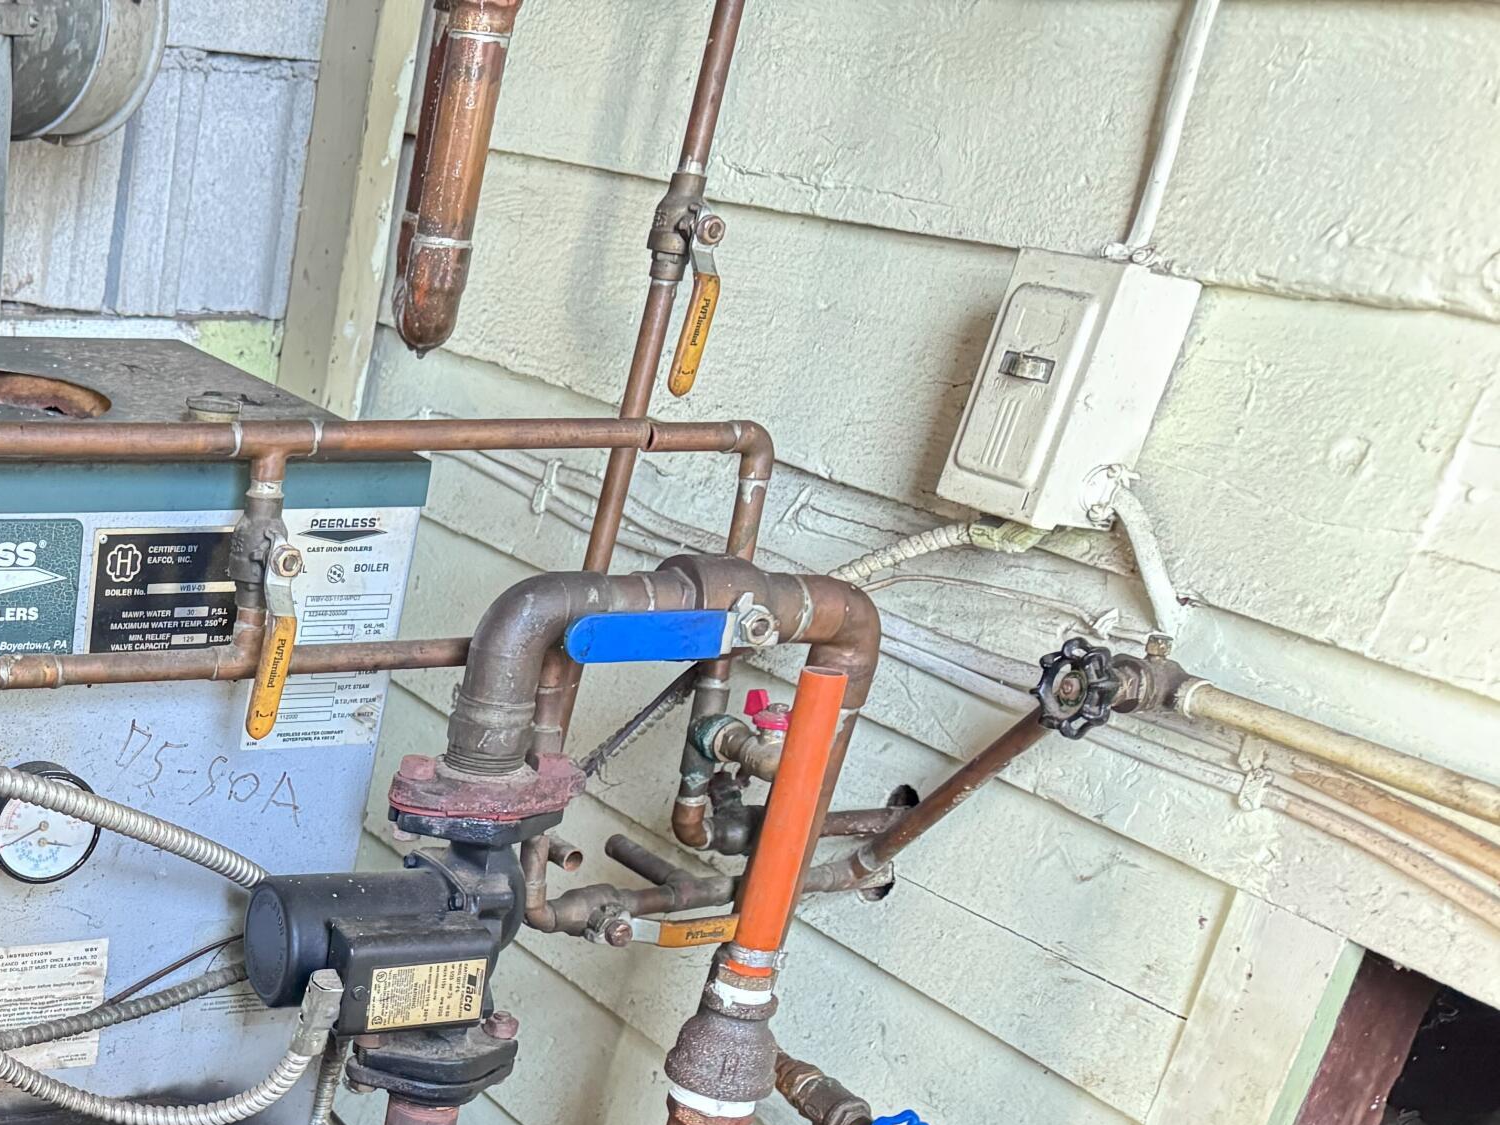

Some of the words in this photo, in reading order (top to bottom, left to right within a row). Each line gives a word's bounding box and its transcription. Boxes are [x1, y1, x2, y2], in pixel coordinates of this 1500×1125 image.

[148, 545, 186, 553] CERTIFIED
[354, 564, 389, 573] BOILER
[105, 589, 132, 597] BOILER
[134, 588, 146, 596] No.
[110, 622, 149, 630] MAXIMUM
[150, 621, 178, 629] WATER
[146, 633, 171, 641] RELIEF
[0, 640, 50, 651] Boyertown,
[53, 640, 67, 650] PA
[110, 643, 133, 651] VALVE
[135, 642, 170, 650] CAPACITY
